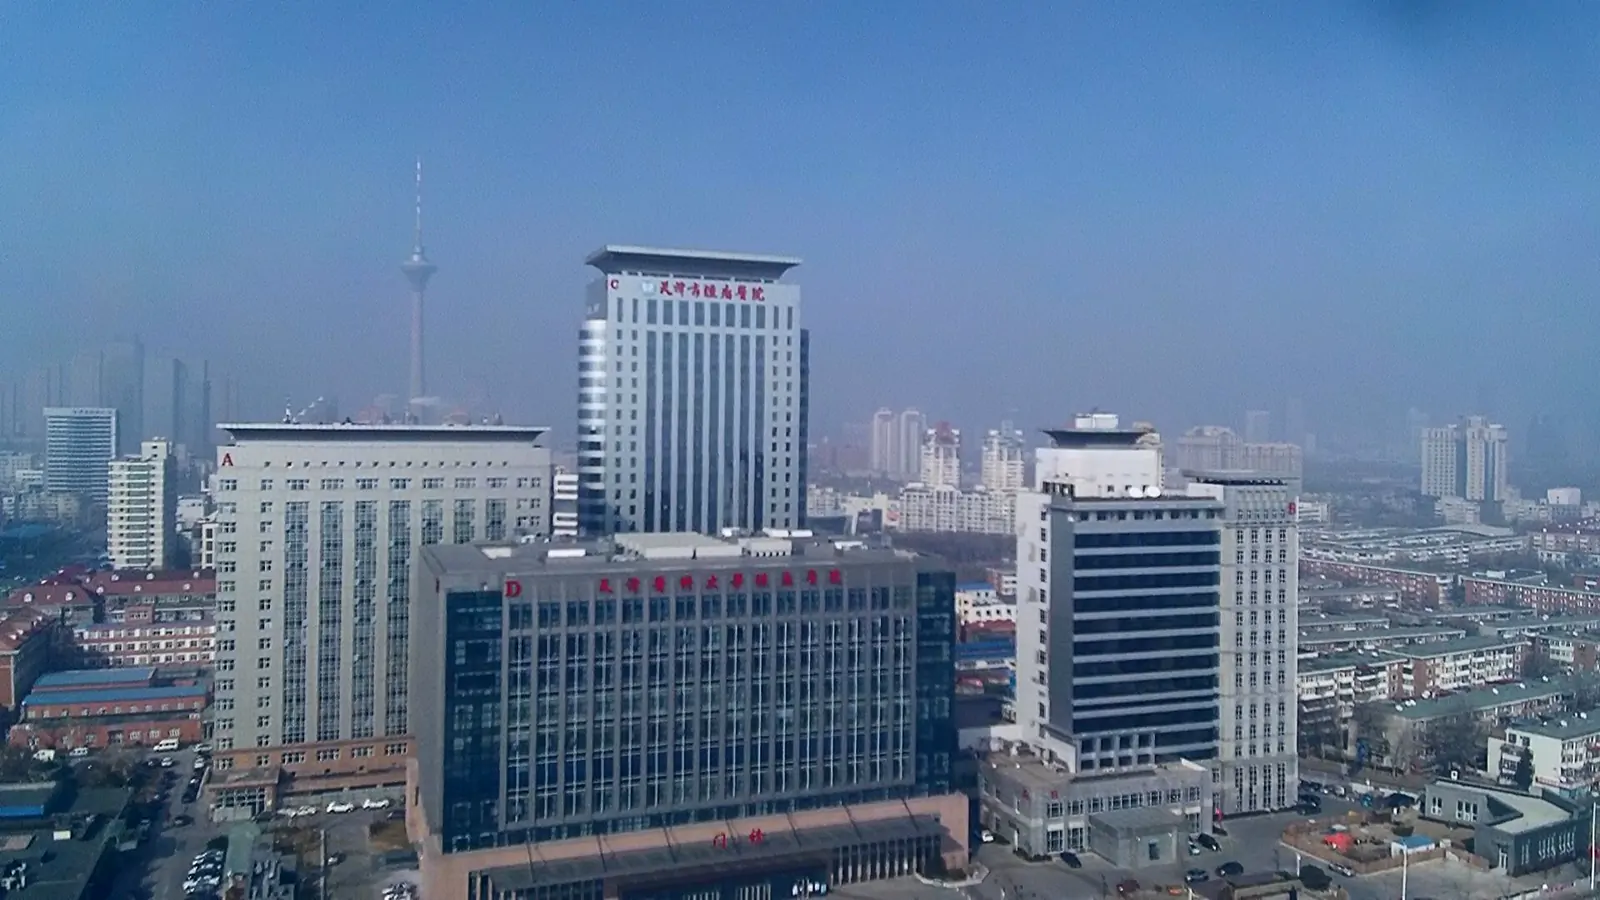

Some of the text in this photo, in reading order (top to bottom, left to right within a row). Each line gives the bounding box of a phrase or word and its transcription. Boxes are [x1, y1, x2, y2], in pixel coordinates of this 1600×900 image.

[611, 280, 619, 290] C
[221, 453, 234, 467] A
[505, 580, 521, 597] D
